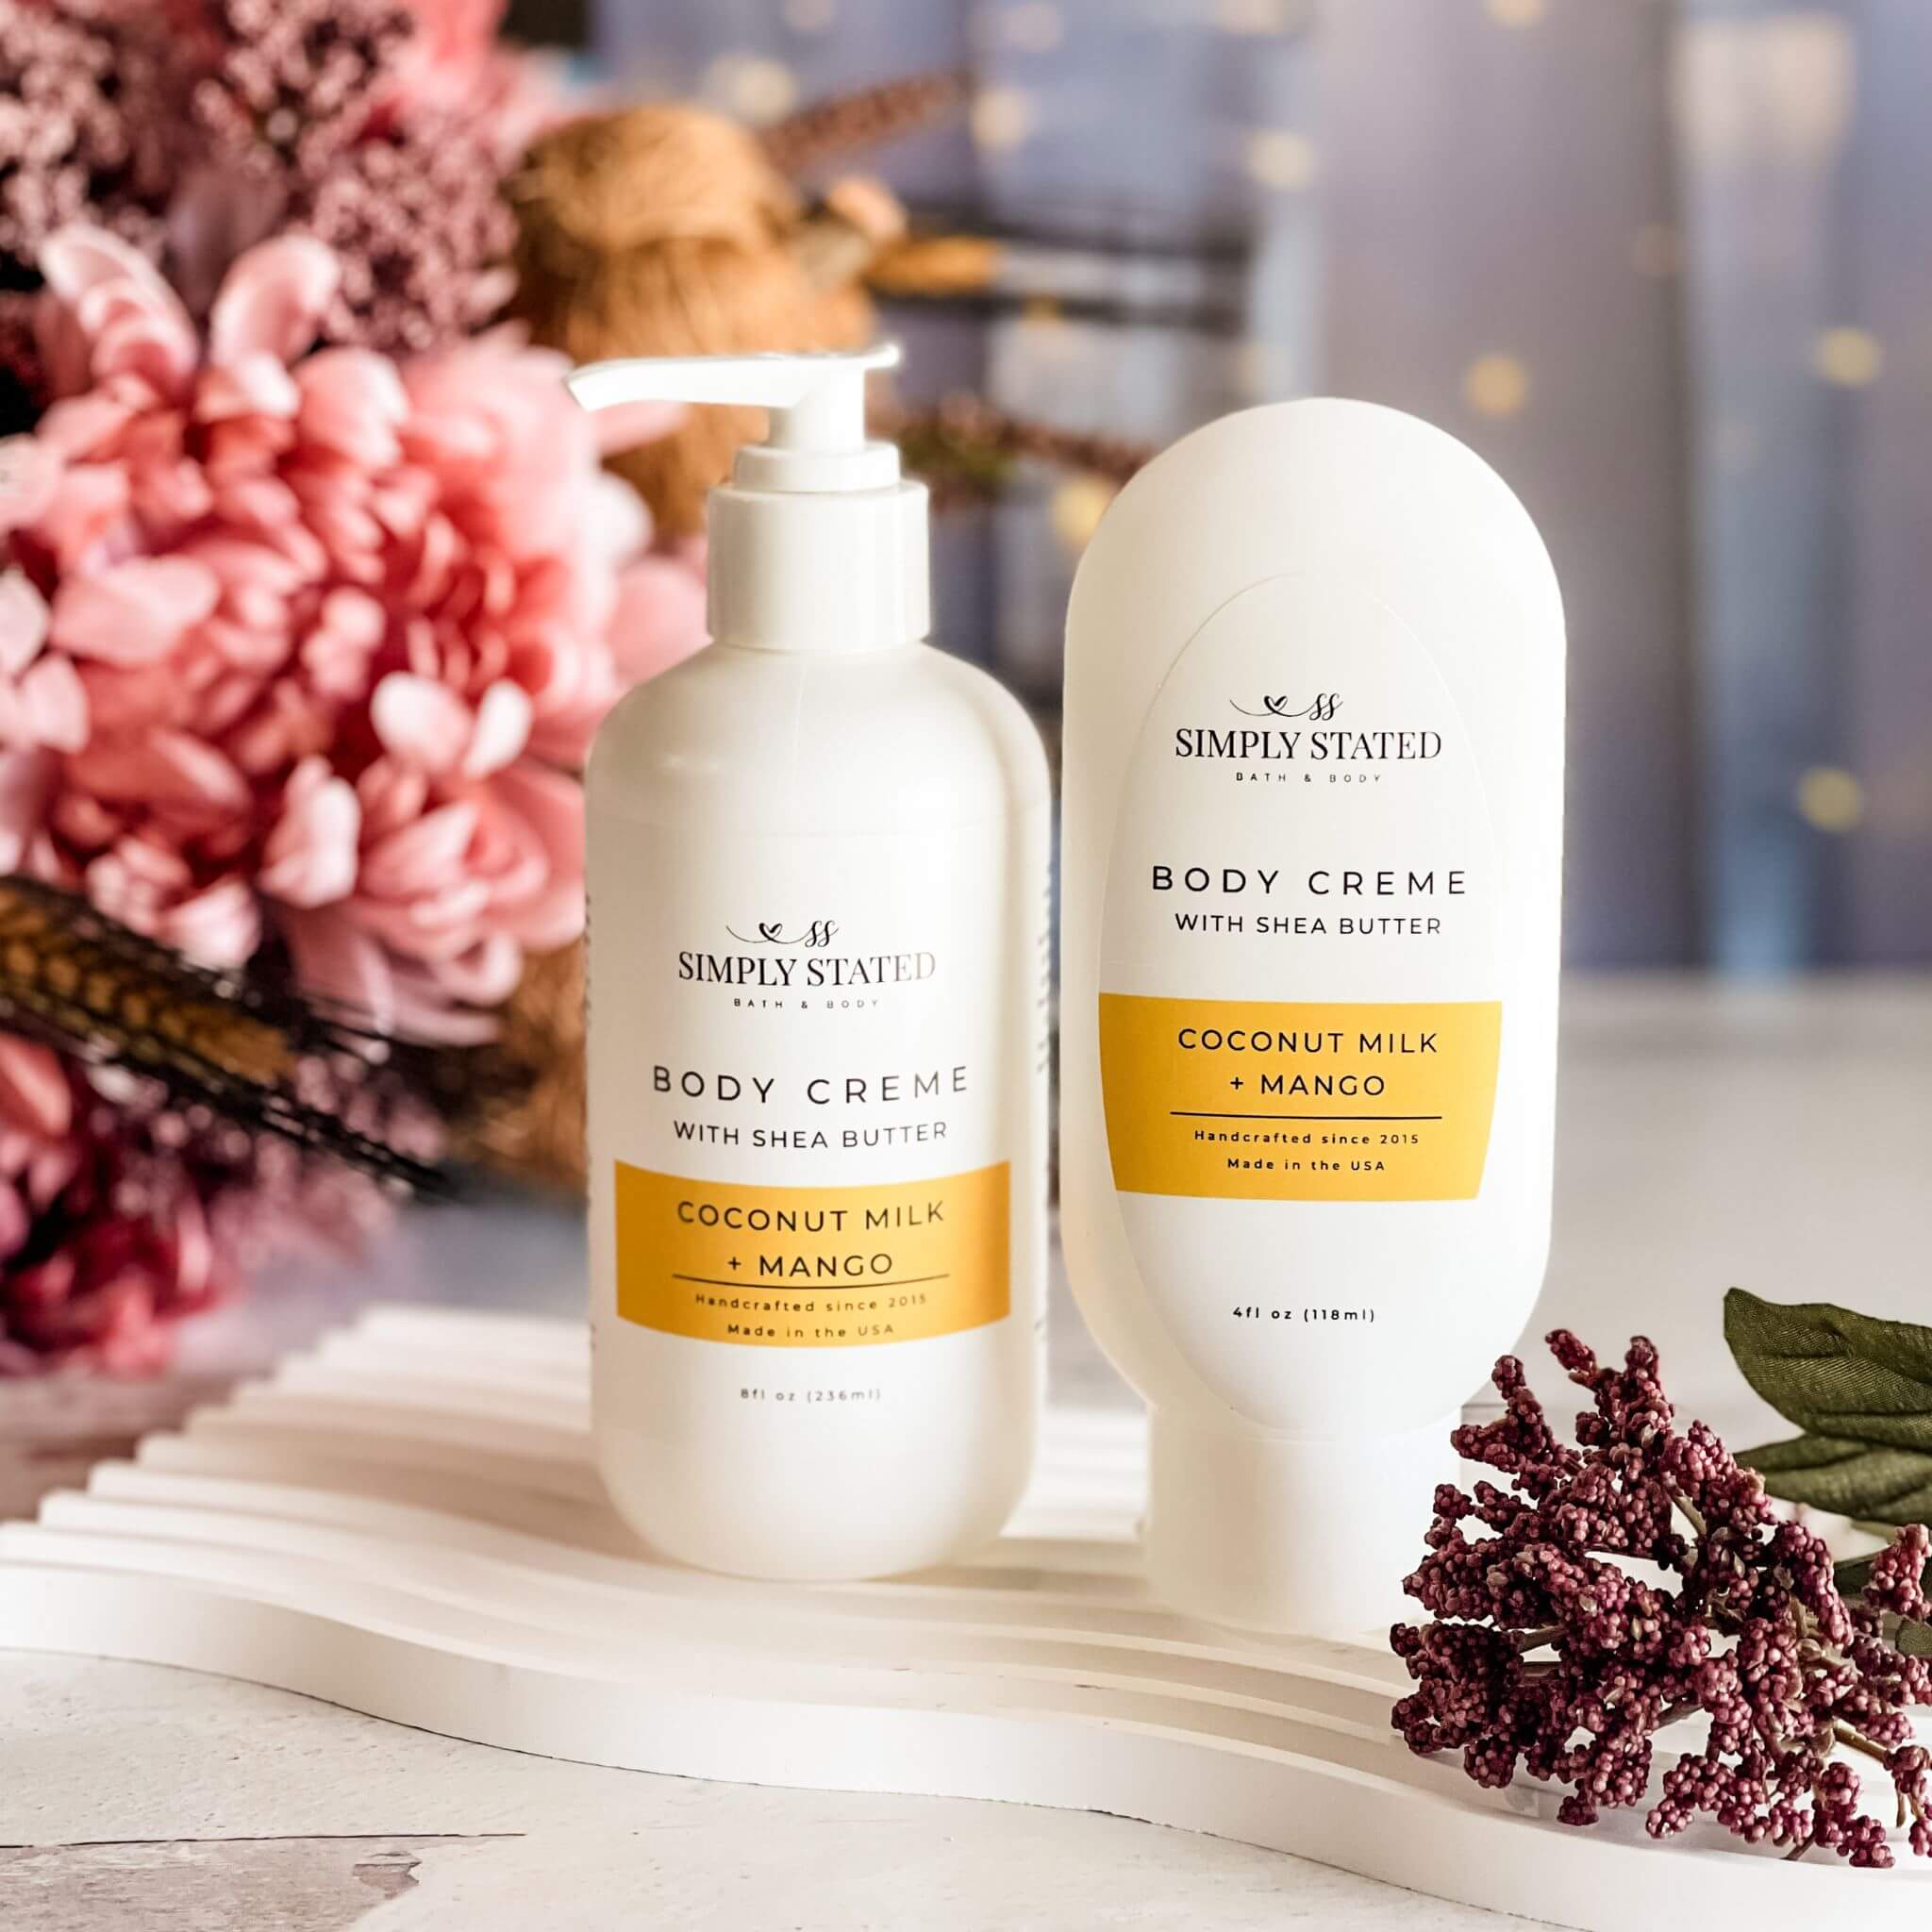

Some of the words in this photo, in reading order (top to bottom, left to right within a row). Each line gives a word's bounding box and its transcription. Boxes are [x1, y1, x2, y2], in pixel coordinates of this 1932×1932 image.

[1174, 727, 1302, 761] SIMPLY
[1309, 731, 1442, 761] STATED
[1235, 771, 1287, 783] BATH
[1303, 773, 1312, 783] &
[1328, 774, 1382, 784] BODY
[1152, 864, 1280, 895] BODY
[1307, 870, 1466, 896] CREME
[1174, 912, 1243, 934] WITH
[1256, 916, 1327, 935] SHEA
[1339, 917, 1441, 936] BUTTER
[678, 951, 798, 987] SIMPLY
[807, 950, 937, 988] STATED
[733, 997, 784, 1009] BATH
[800, 1000, 808, 1009] &
[826, 998, 879, 1009] BODY
[1177, 1027, 1344, 1054] COCONUT
[1358, 1032, 1438, 1055] MILK
[653, 1064, 775, 1105] BODY
[807, 1065, 968, 1106] CREME
[1230, 1075, 1244, 1091] +
[1260, 1073, 1385, 1096] MANGO
[673, 1120, 740, 1145] WITH
[752, 1127, 829, 1149] SHEA
[841, 1122, 947, 1148] BUTTER
[1194, 1129, 1312, 1144] Handcrafted
[1321, 1132, 1371, 1145] since
[1378, 1133, 1419, 1145] 2015
[1226, 1158, 1274, 1170] Made
[1284, 1158, 1301, 1171] in
[1310, 1160, 1341, 1171] the
[1350, 1159, 1385, 1172] USA
[677, 1200, 849, 1233] COCONUT
[865, 1200, 945, 1231] MILK
[727, 1256, 742, 1272] +
[758, 1253, 893, 1278] MANGO
[695, 1294, 815, 1312] Handcrafted
[825, 1299, 878, 1312] since
[889, 1293, 926, 1308] 2015
[1232, 1306, 1260, 1320] 4fl
[1271, 1308, 1292, 1321] oz
[1303, 1307, 1375, 1324] (118ml)
[727, 1324, 775, 1338] Made
[786, 1328, 804, 1338] in
[814, 1327, 847, 1339] the
[858, 1324, 894, 1338] USA
[741, 1388, 766, 1399] 8fl
[775, 1391, 796, 1402] oz
[807, 1389, 882, 1403] (236ml)
